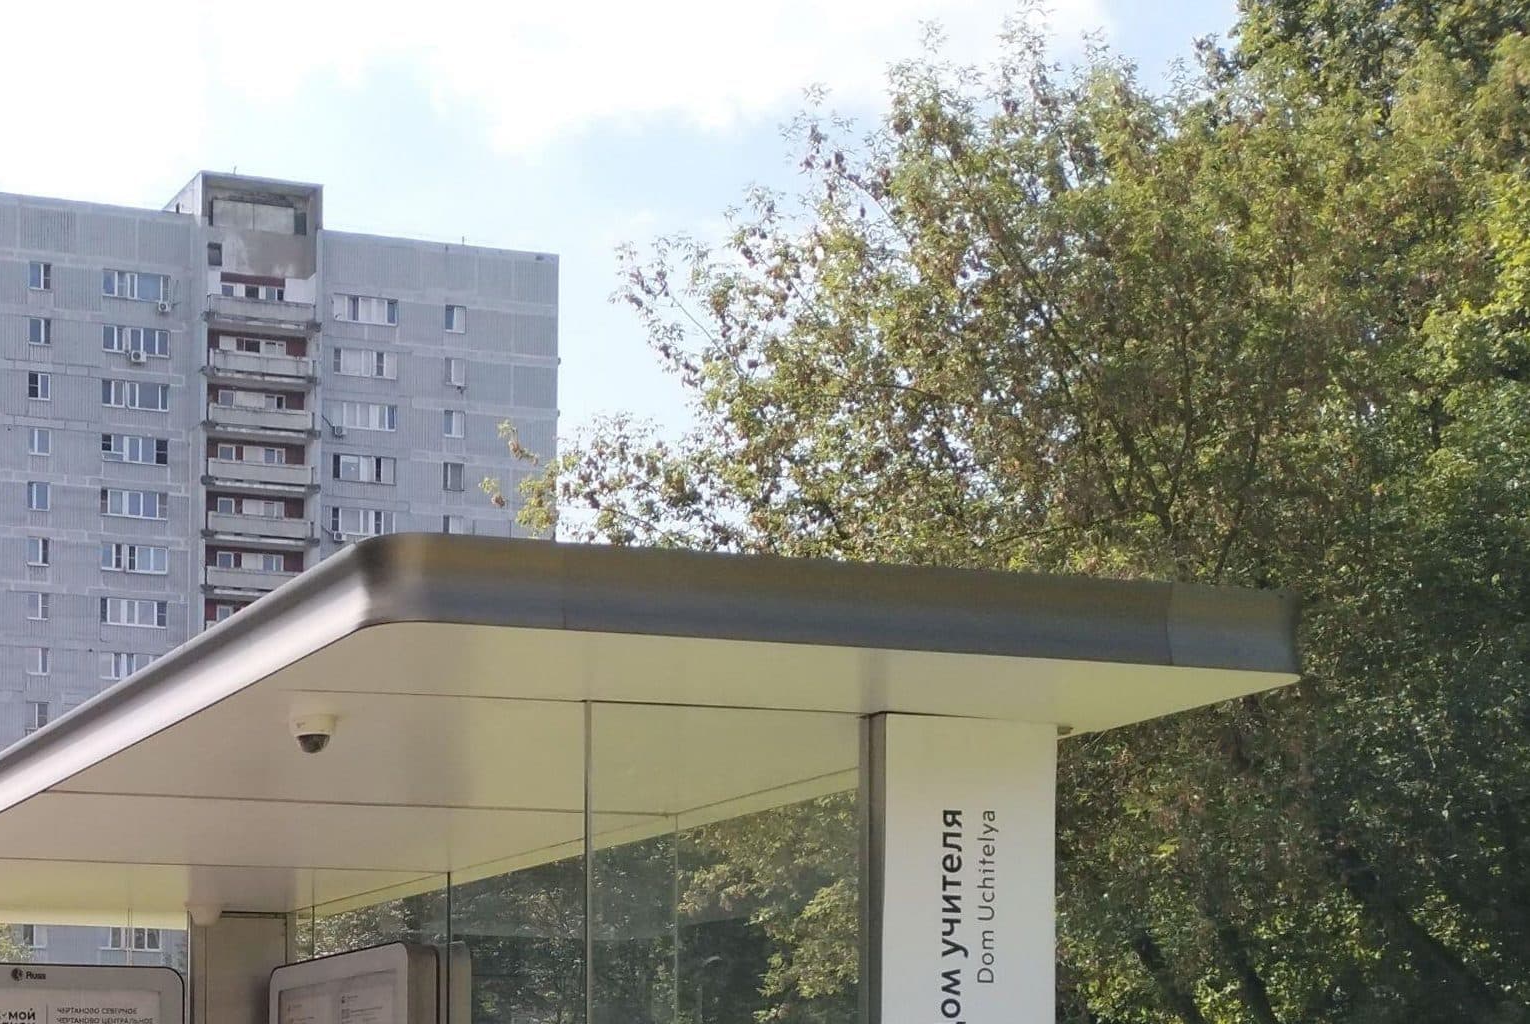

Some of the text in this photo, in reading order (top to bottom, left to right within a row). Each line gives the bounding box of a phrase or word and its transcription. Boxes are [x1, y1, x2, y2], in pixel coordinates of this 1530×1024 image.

[941, 809, 968, 958] учителя
[977, 810, 999, 983] Dom Uchitelya
